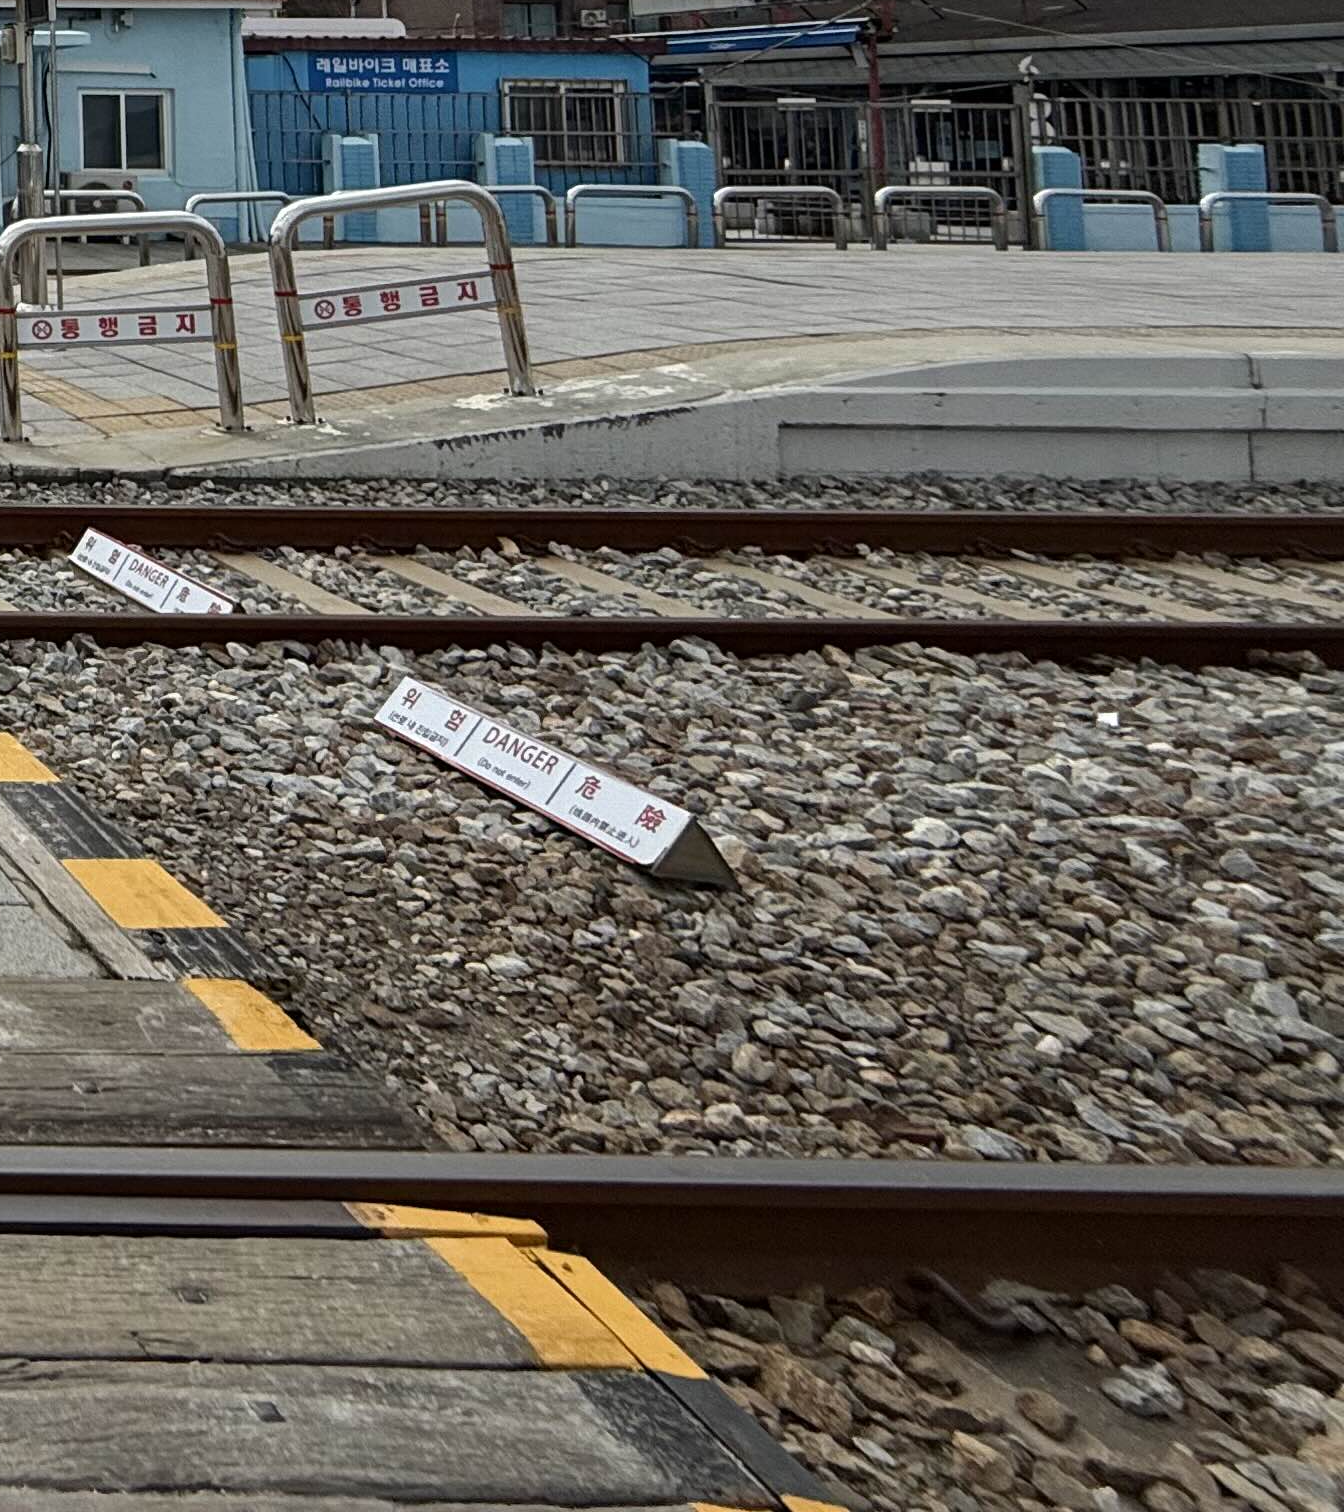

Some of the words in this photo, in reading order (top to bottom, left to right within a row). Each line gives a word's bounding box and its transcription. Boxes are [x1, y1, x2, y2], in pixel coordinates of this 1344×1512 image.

[315, 56, 396, 74] 레일바이크
[403, 56, 450, 74] 매표소
[325, 78, 370, 89] Railbike
[372, 78, 406, 89] Ticket
[408, 78, 444, 89] Office
[128, 558, 170, 588] DANGER
[482, 726, 560, 775] DANGER
